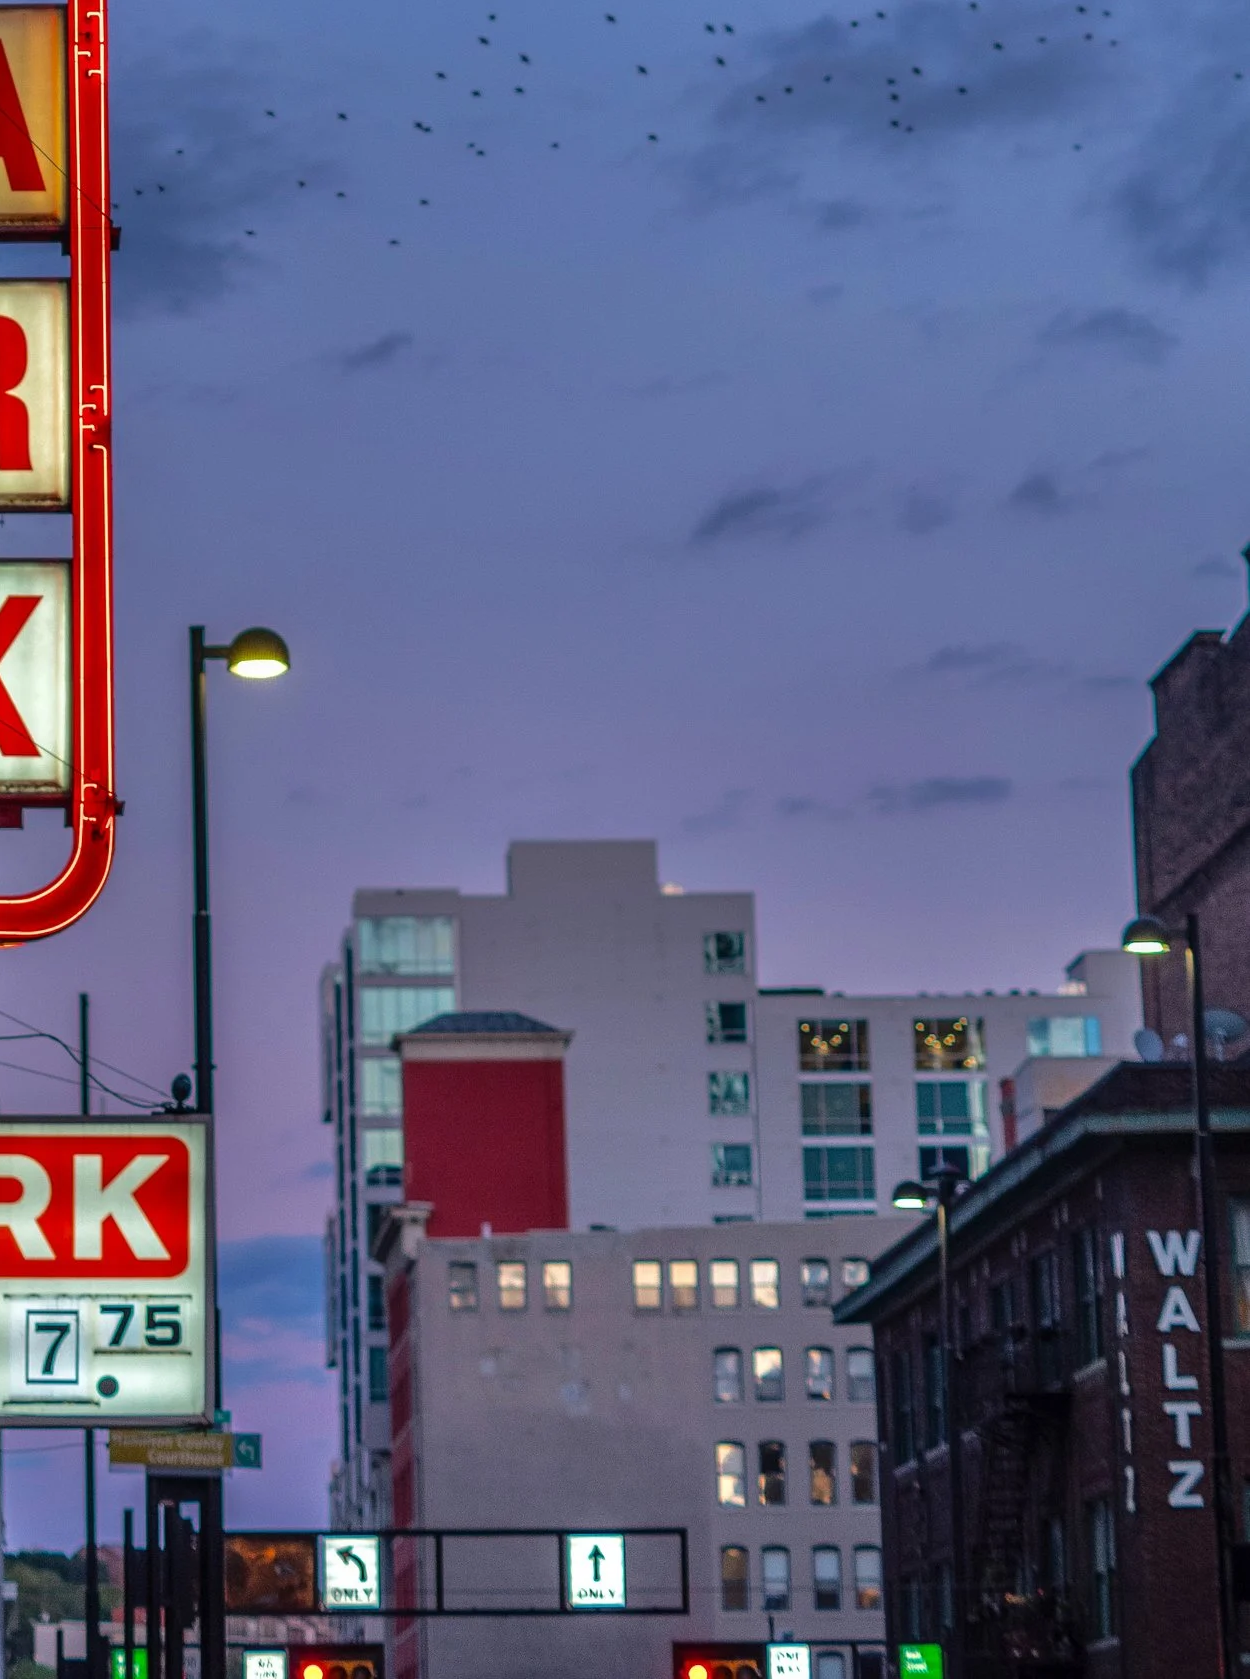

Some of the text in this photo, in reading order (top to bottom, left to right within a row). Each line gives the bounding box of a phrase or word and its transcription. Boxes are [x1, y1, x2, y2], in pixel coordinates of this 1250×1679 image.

[1147, 1229, 1205, 1509] WALTZ
[330, 1587, 373, 1602] ONLY
[577, 1587, 616, 1600] ONLY
